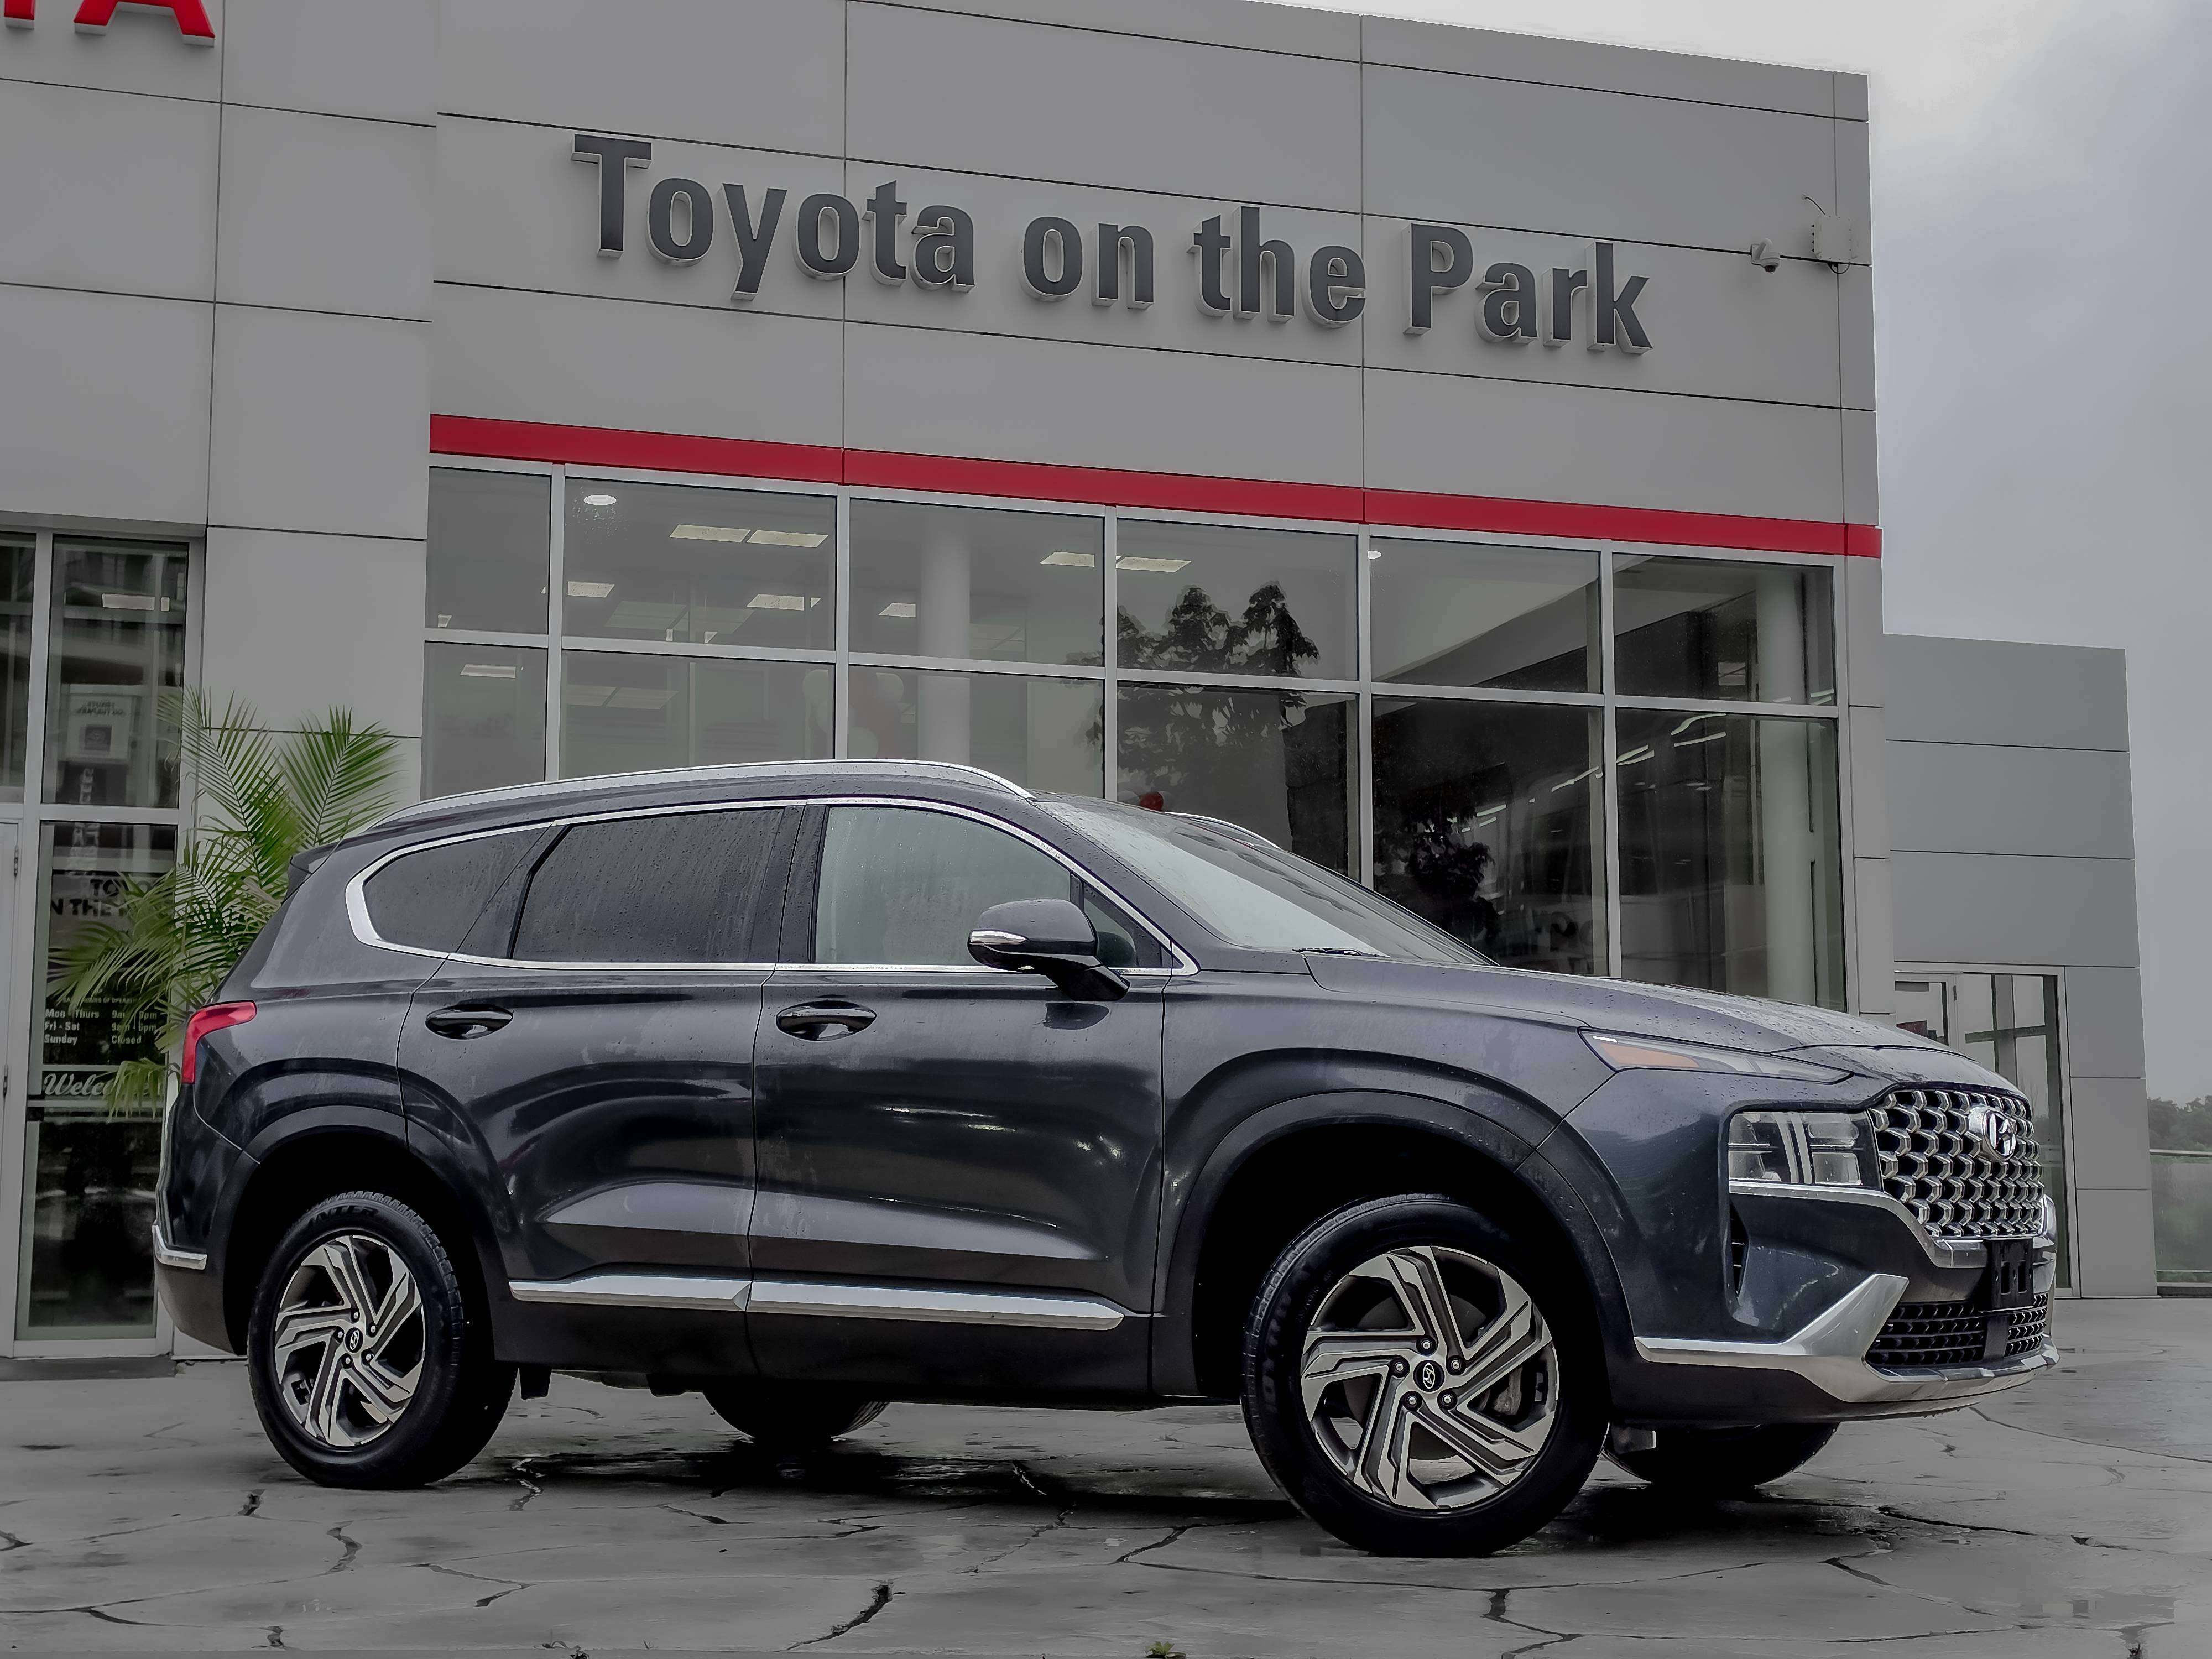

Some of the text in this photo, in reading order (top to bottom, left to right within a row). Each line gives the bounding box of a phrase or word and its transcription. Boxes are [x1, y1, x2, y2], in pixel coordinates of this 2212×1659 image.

[572, 134, 1653, 354] Toyota on the Park
[45, 1008, 65, 1018] Mon
[75, 1010, 100, 1019] Thurs
[44, 1021, 56, 1031] Fri
[65, 1021, 80, 1031] Sat
[44, 1033, 78, 1046] Sunday
